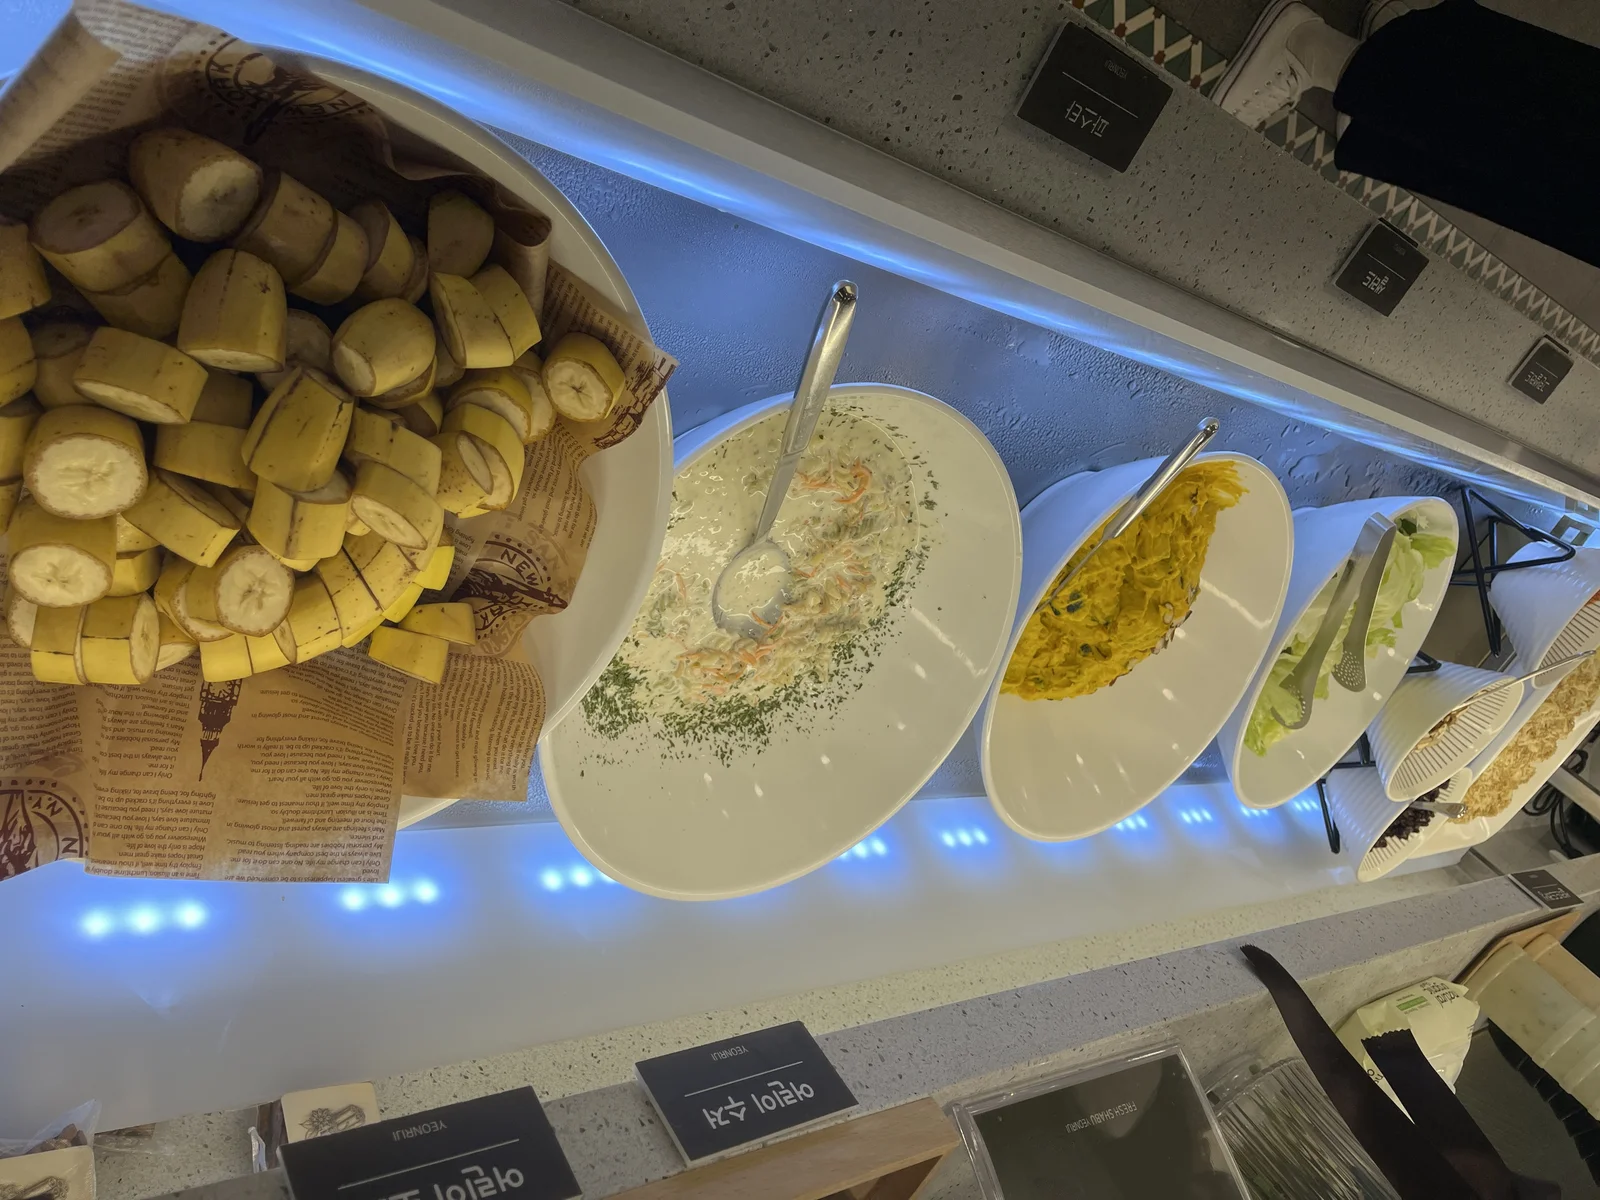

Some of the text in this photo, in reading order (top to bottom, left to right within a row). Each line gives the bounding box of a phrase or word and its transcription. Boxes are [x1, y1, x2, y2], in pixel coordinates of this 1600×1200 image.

[1065, 101, 1109, 137] 파스타
[501, 549, 539, 586] NEW
[353, 778, 393, 788] Wheresoever
[108, 786, 132, 795] risking
[190, 790, 217, 799] fighting
[353, 792, 374, 800] hopes
[157, 797, 192, 806] everything
[366, 801, 390, 809] Employ
[233, 821, 261, 830] glowing
[255, 840, 284, 848] listening
[711, 1045, 749, 1061] YEONRIJI
[702, 1080, 815, 1130] 어린이 수저
[1113, 1100, 1138, 1117] FRESH
[1089, 1108, 1115, 1126] SHABU
[392, 1120, 448, 1142] YEONRIJI
